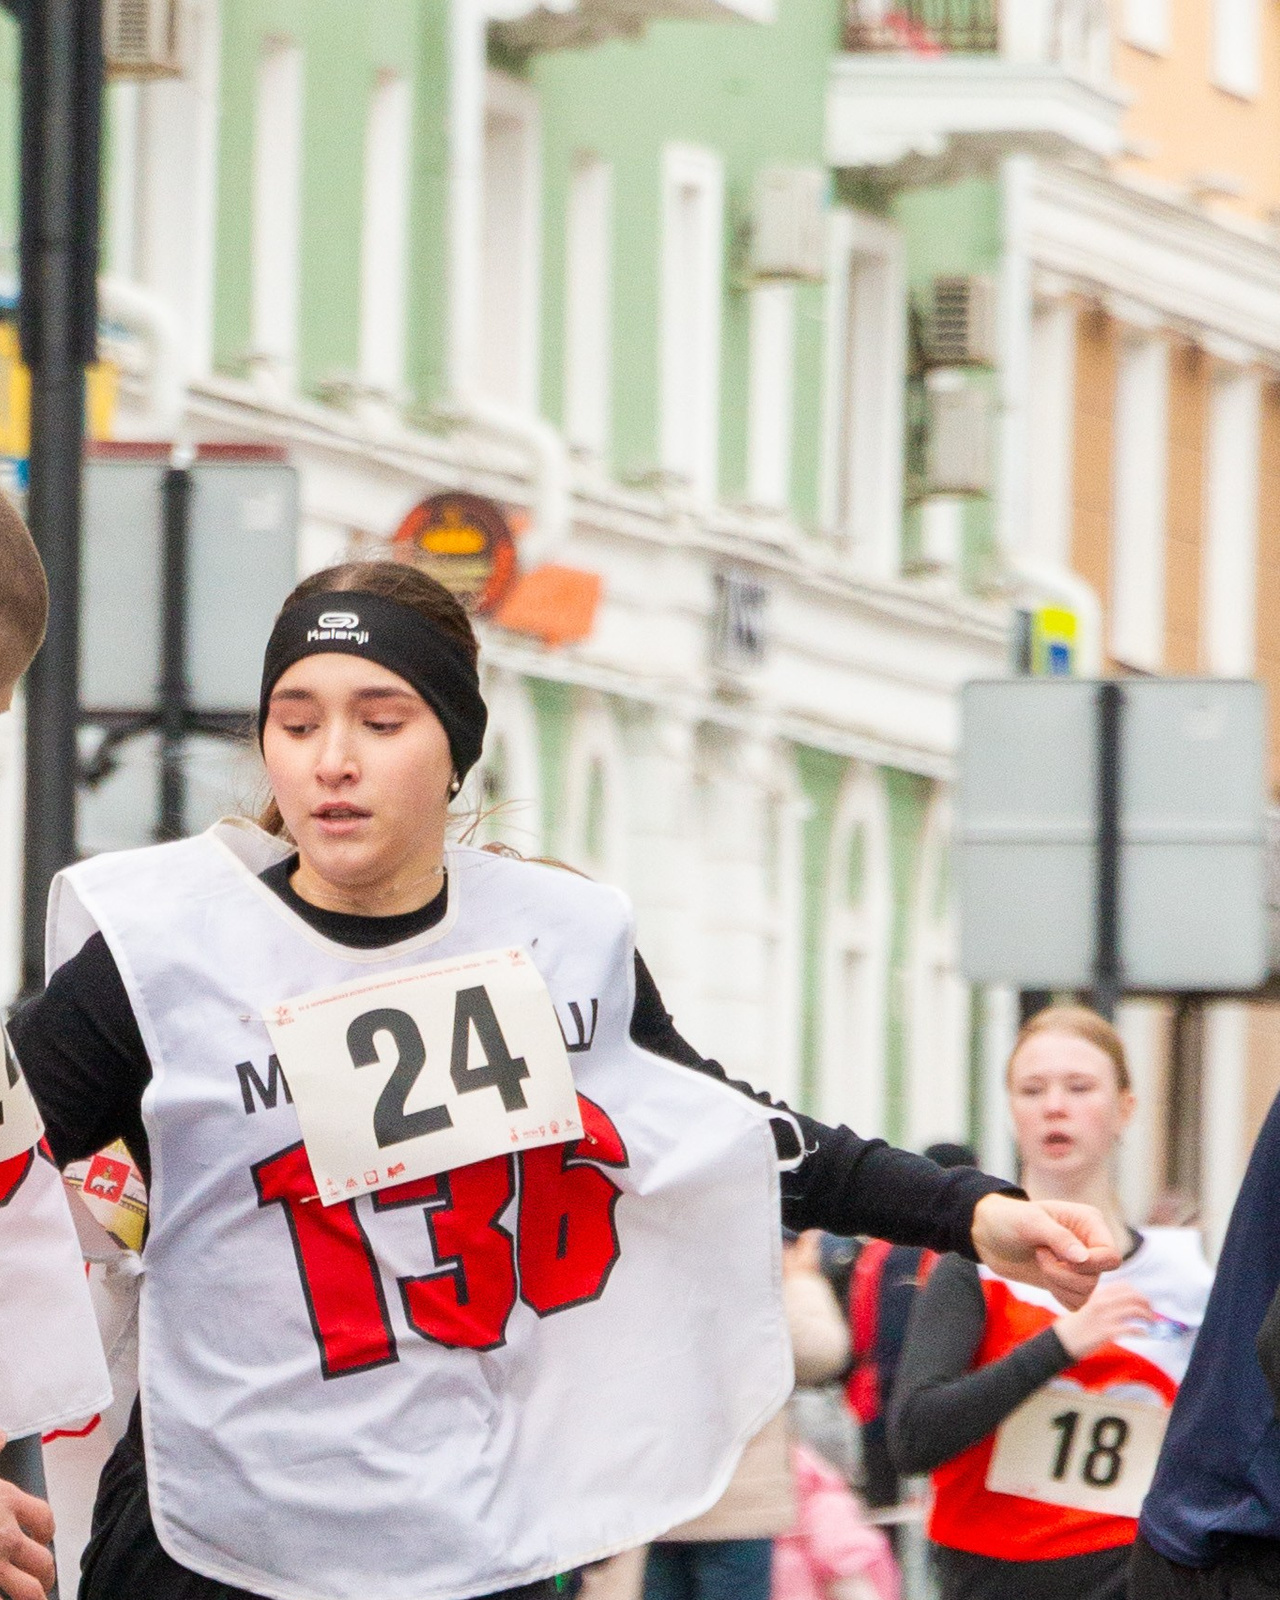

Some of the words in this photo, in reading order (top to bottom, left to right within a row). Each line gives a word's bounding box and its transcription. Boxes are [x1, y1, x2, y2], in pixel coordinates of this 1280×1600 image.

[346, 985, 531, 1150] 24
[250, 1091, 631, 1381] 136
[1051, 1410, 1129, 1487] 18
